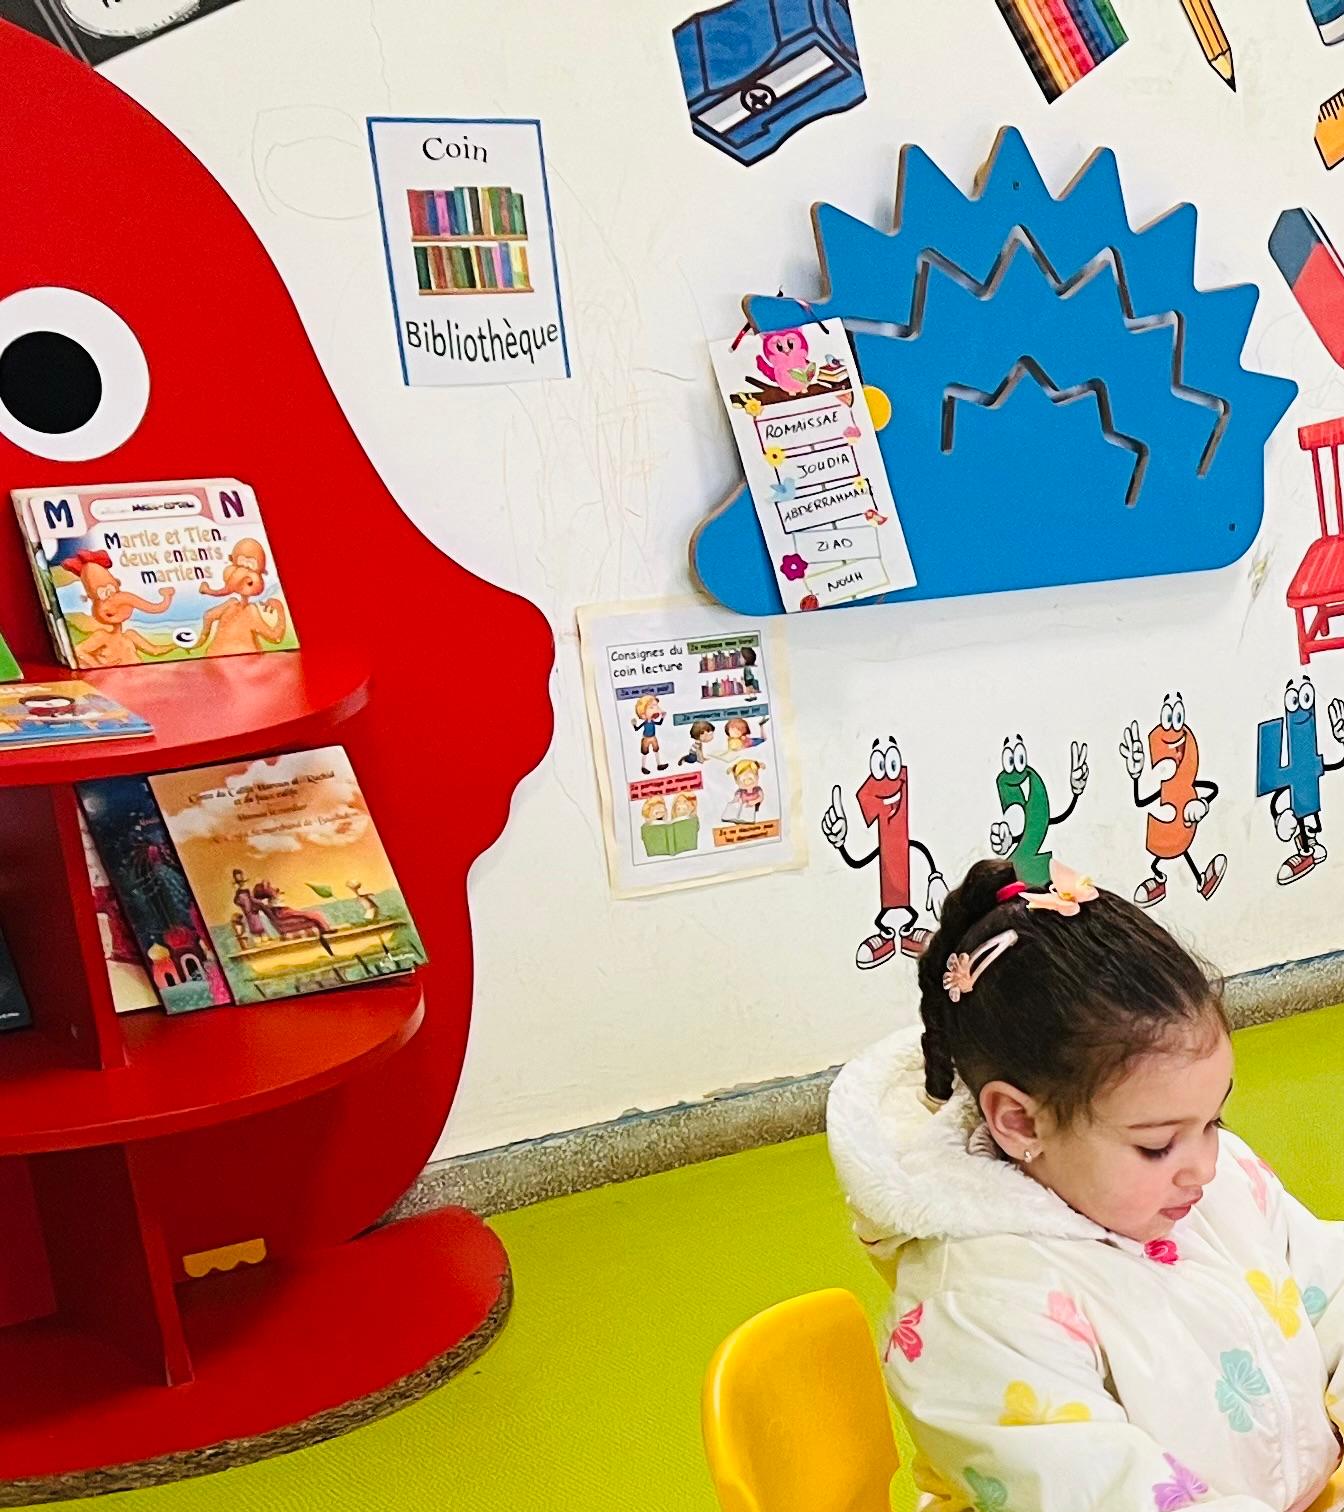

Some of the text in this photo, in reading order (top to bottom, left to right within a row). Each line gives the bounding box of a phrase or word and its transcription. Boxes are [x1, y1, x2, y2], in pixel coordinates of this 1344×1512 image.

[422, 135, 488, 164] Coin
[405, 318, 559, 364] Bibliothèque
[44, 500, 74, 529] M
[219, 490, 244, 518] N
[165, 528, 181, 546] et
[119, 545, 224, 567] deux enfants
[141, 564, 213, 585] martiens
[827, 572, 864, 592] NOUH
[611, 647, 665, 662] Consignes
[670, 645, 683, 656] du
[613, 661, 683, 678] coin lecture
